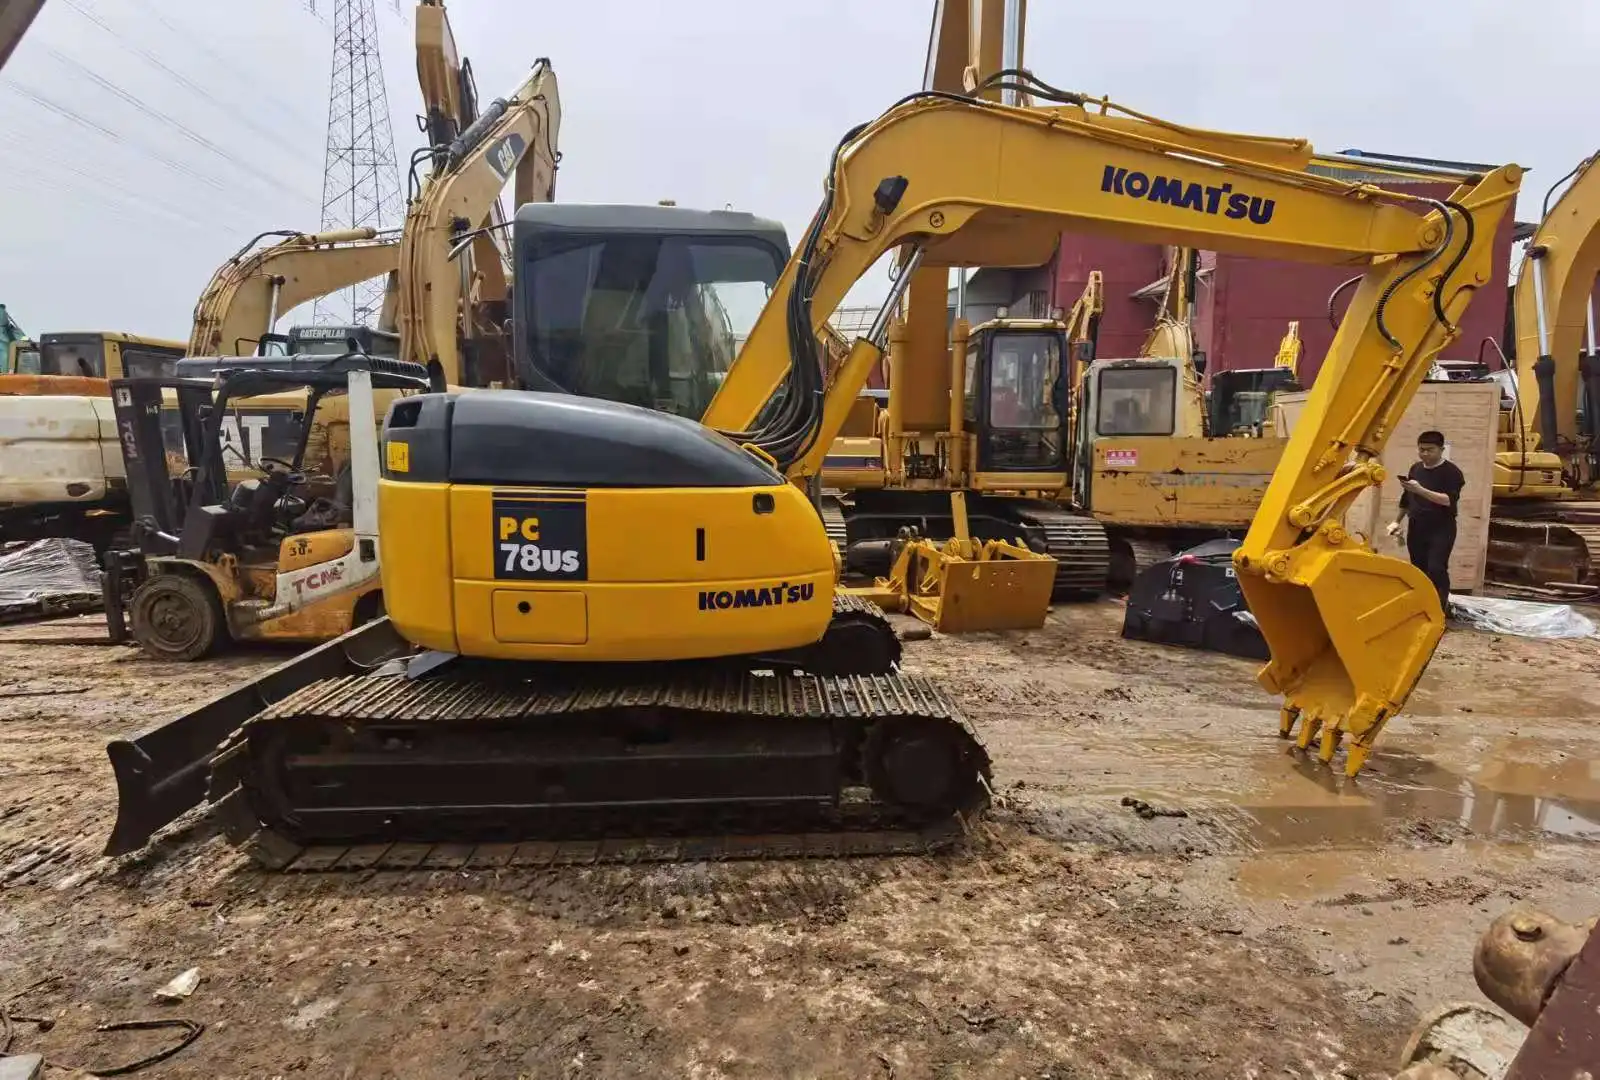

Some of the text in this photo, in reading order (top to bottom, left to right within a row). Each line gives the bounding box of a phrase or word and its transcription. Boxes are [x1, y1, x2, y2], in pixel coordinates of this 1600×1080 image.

[497, 137, 516, 173] CAT
[1100, 165, 1276, 224] KOMATSU
[300, 328, 346, 339] CATERPILLAR
[183, 415, 269, 472] AT
[500, 516, 540, 540] PC
[500, 543, 580, 573] 78US
[698, 581, 815, 611] KOMATSU
